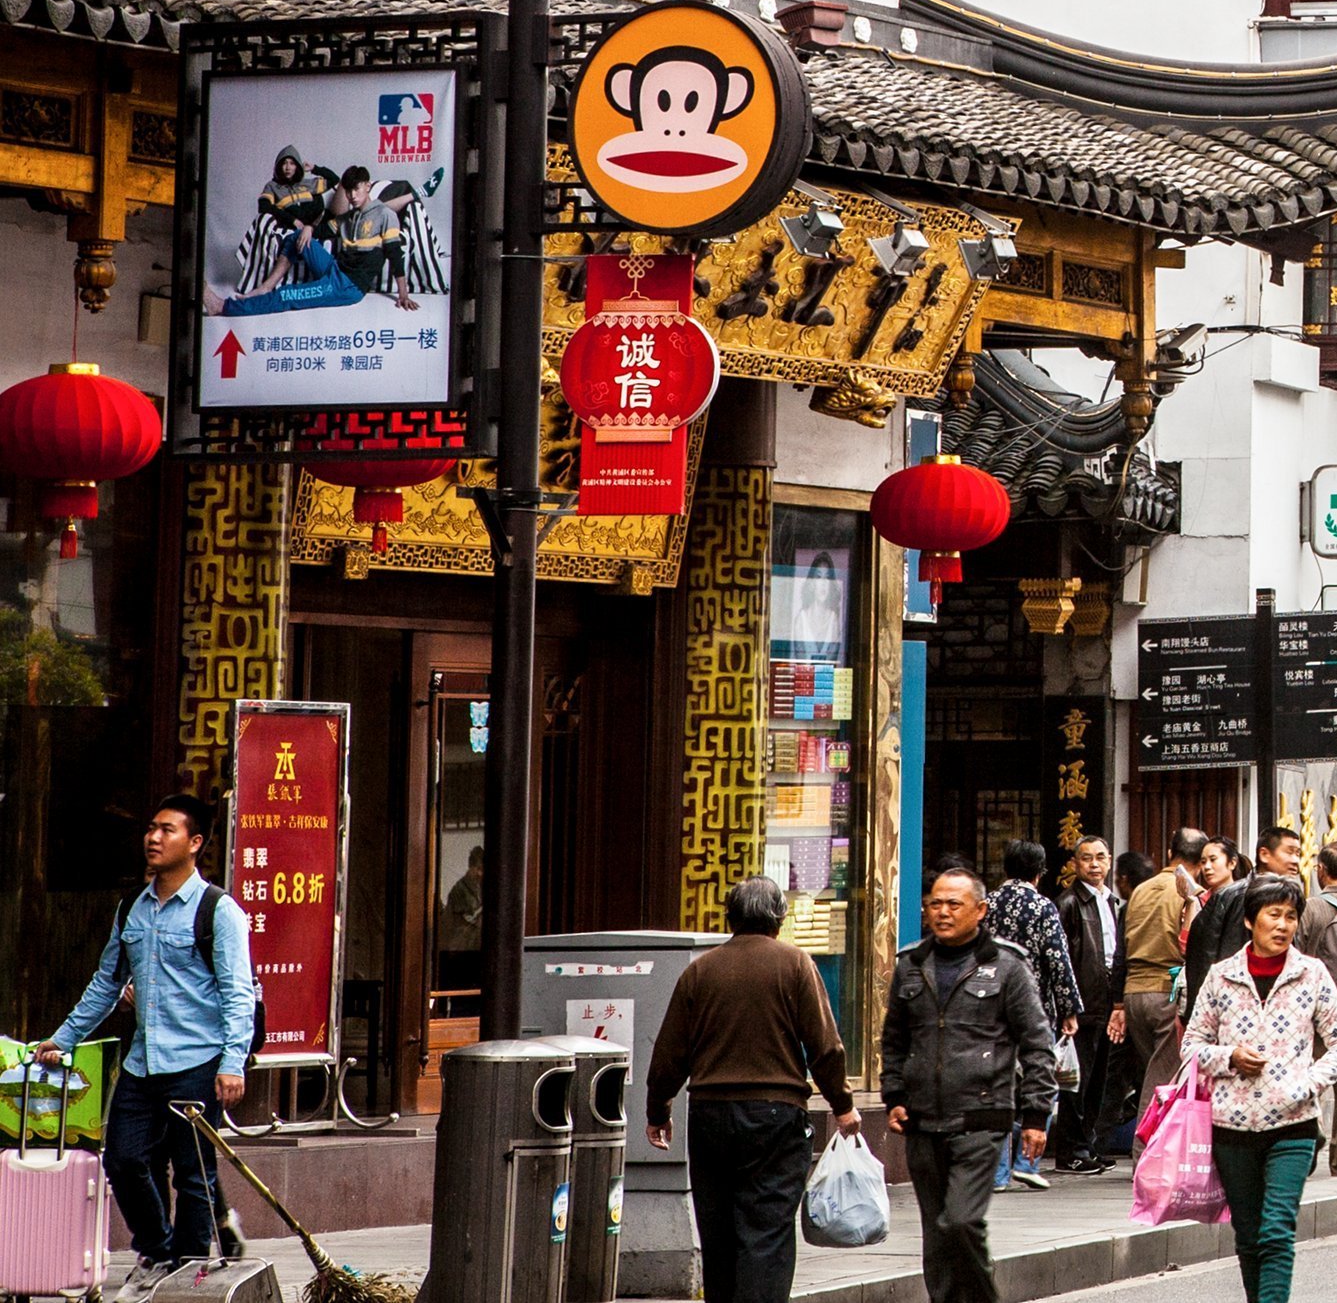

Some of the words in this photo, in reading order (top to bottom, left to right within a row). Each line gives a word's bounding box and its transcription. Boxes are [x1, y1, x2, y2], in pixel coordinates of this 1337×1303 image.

[378, 125, 434, 154] MLB
[378, 154, 432, 163] UNDERWEAR
[280, 286, 323, 302] YANKEES
[252, 328, 438, 352] 黄浦区旧校场路69号一楼
[266, 356, 326, 372] 向前30米
[340, 355, 383, 371] 豫园店
[614, 332, 660, 409] 诚信
[1161, 636, 1209, 648] 南翔馒头店
[1162, 675, 1181, 686] 豫园
[1197, 673, 1226, 684] 湖心亭
[1162, 694, 1201, 705] 豫园老街
[1162, 721, 1201, 733] 老庙黄金
[1218, 718, 1247, 730] 九曲桥
[1162, 742, 1229, 754] 上海五香豆商店
[243, 848, 268, 868] 翡翠
[242, 880, 267, 901] 钻石
[273, 872, 325, 904] 6.8折
[257, 964, 303, 975] 特价商品除外
[582, 1003, 623, 1020] 止步,
